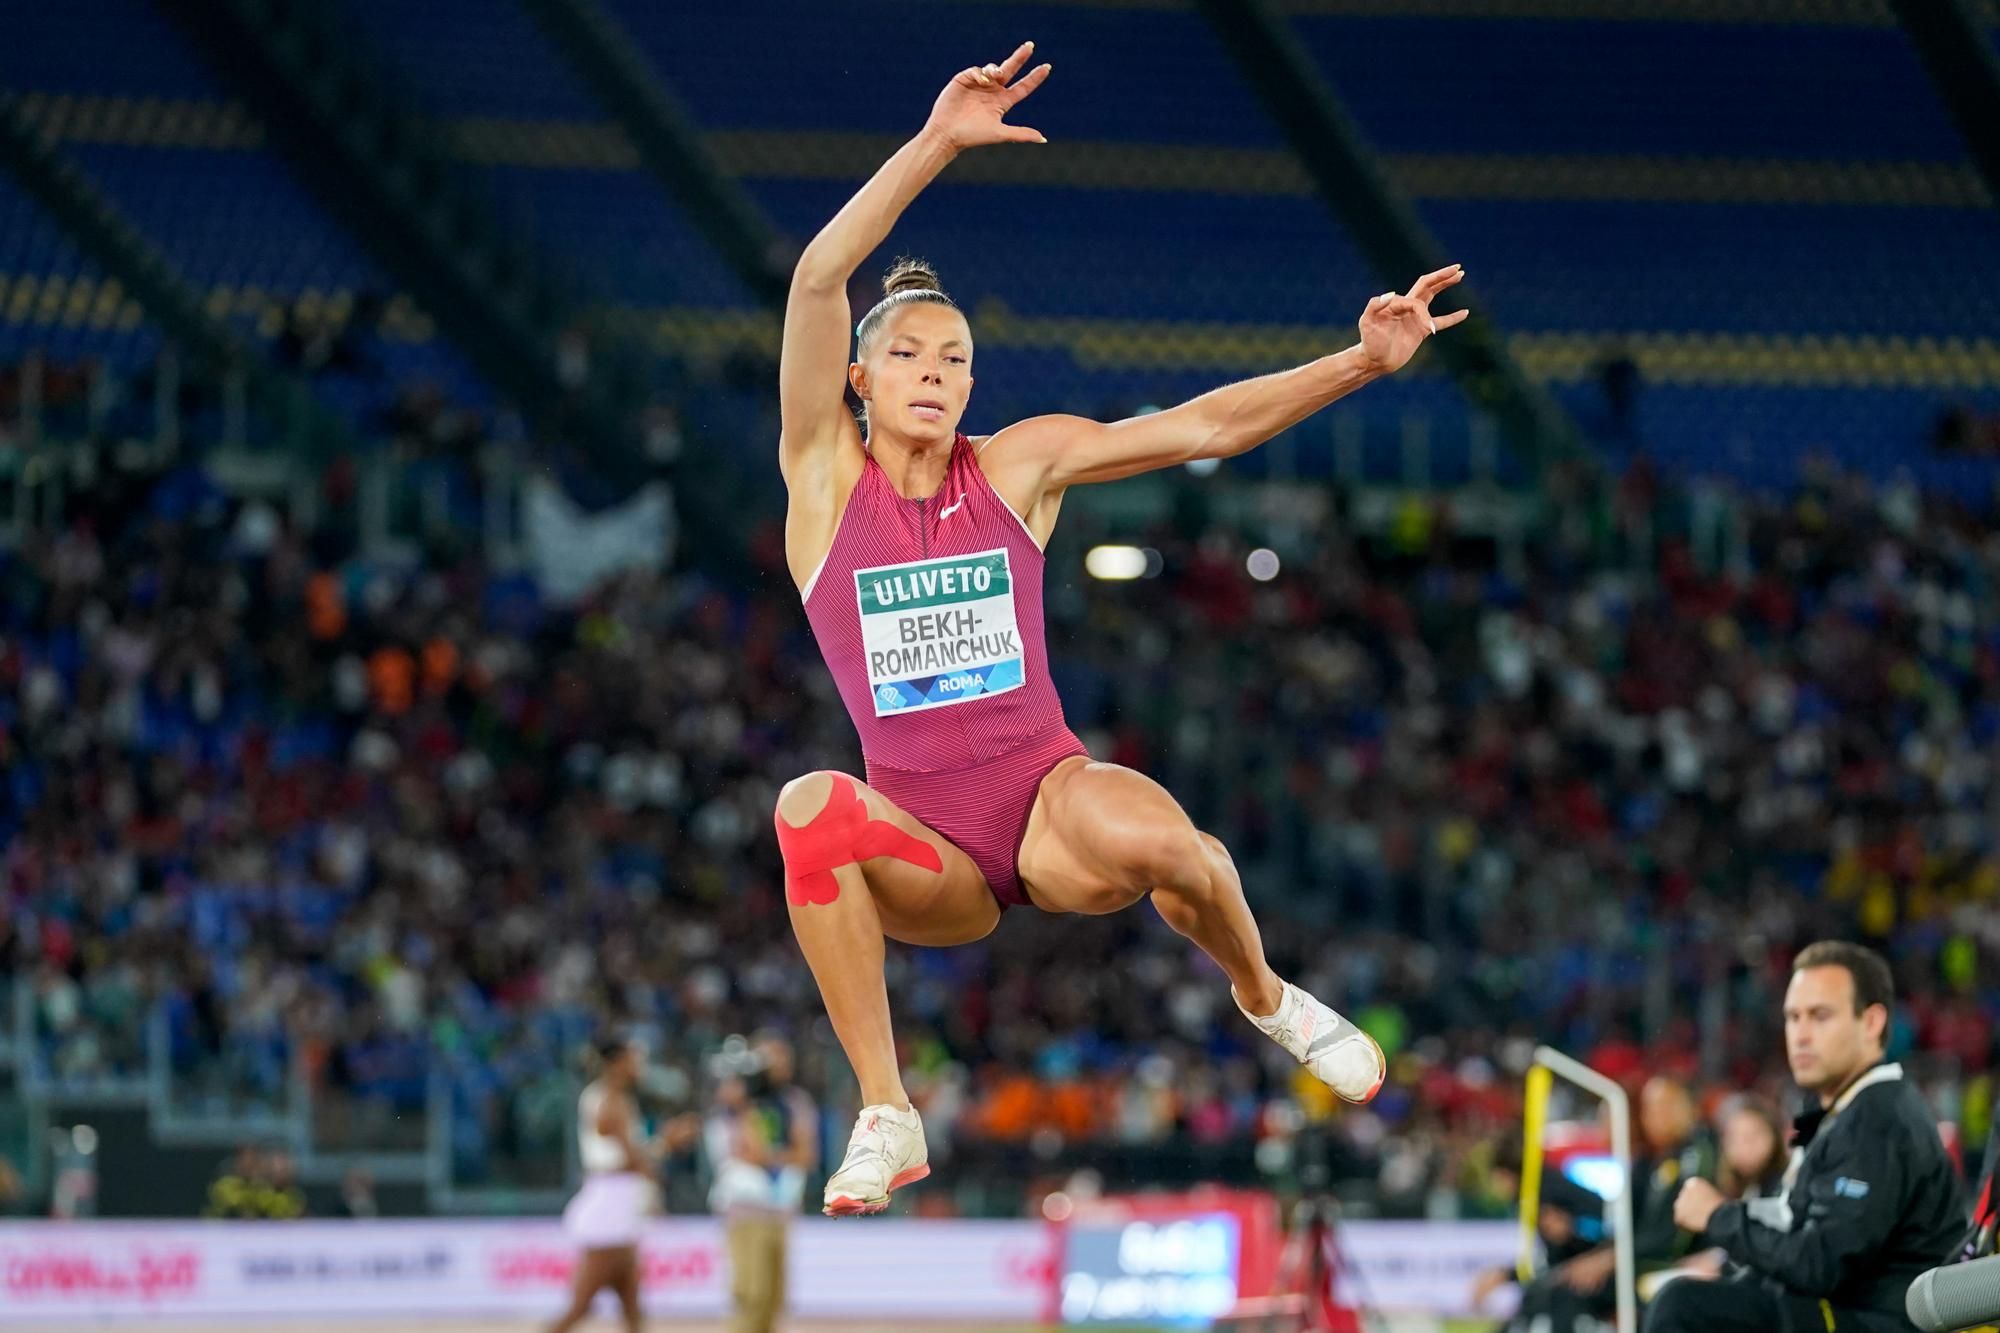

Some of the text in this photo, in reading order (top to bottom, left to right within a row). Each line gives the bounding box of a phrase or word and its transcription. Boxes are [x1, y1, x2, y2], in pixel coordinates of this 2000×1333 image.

[874, 566, 991, 606] ULIVETO
[899, 609, 983, 644] BEKH-
[871, 630, 1018, 677] ROMANCHUK
[939, 673, 985, 693] ROMA
